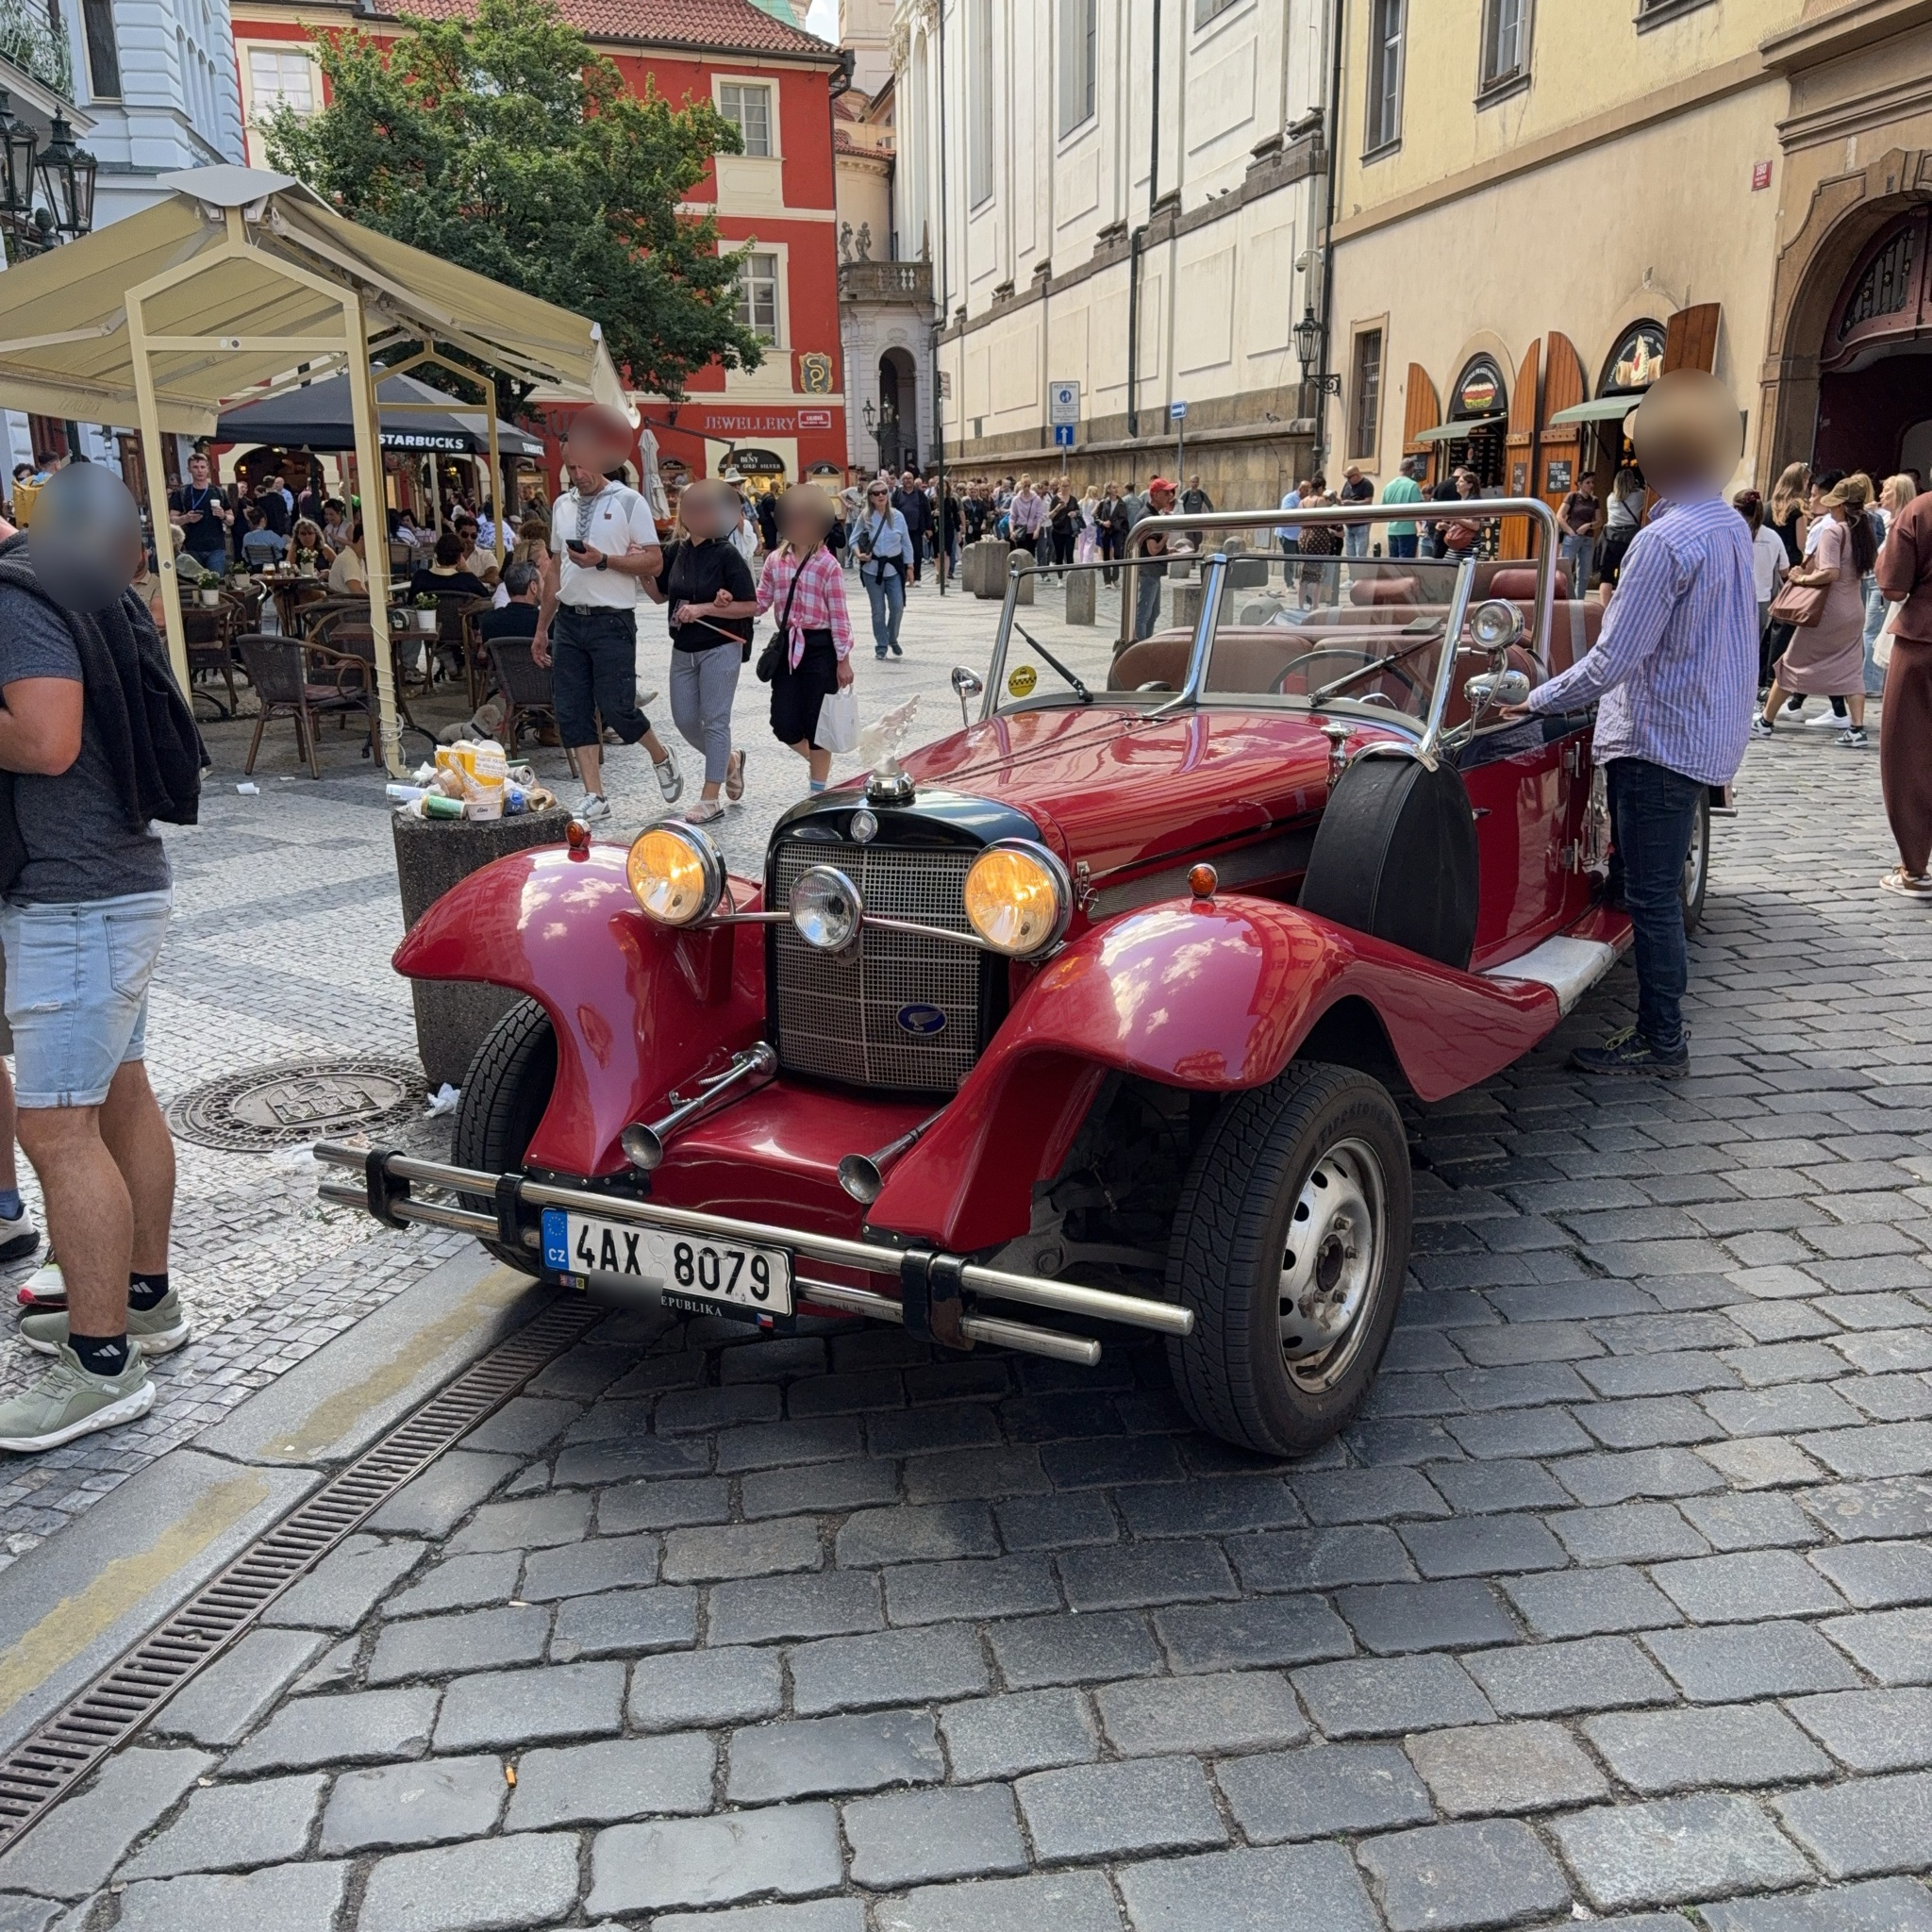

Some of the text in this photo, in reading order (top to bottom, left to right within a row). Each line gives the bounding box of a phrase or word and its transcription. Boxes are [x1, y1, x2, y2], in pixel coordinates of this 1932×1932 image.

[705, 416, 796, 430] JEWELLERY
[379, 433, 464, 450] STARBUCKS
[548, 1247, 566, 1263] CZ
[576, 1224, 771, 1302] 4AX 8079
[660, 1295, 723, 1318] EPUBLIKA
